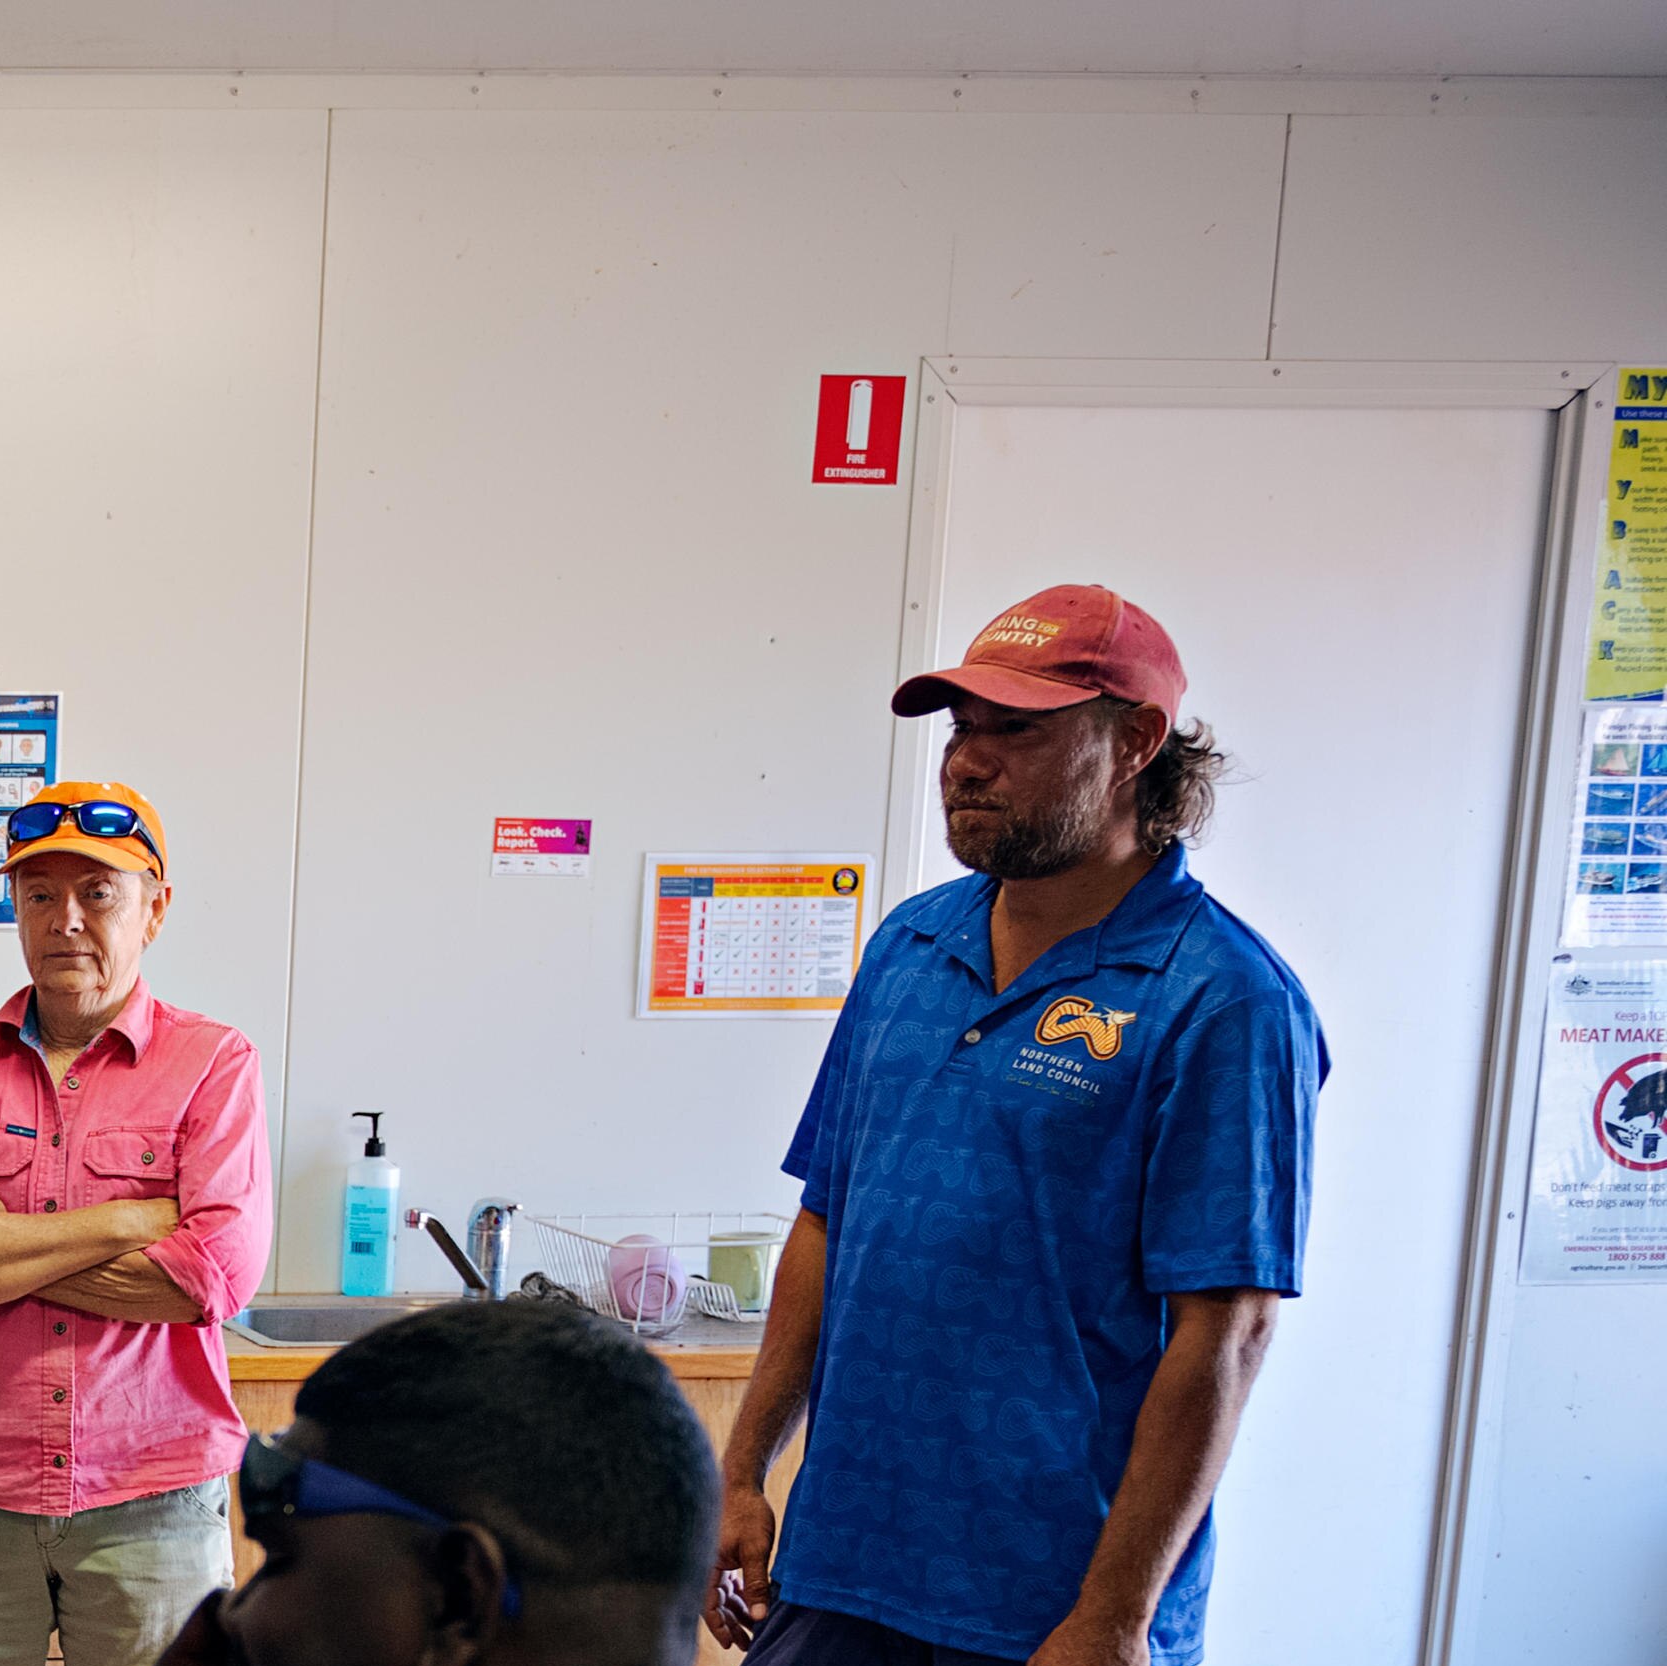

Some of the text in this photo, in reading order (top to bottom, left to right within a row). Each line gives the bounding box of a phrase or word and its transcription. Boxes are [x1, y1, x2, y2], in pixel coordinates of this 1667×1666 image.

[846, 453, 866, 464] FIRE
[824, 467, 886, 479] EXTINGUISHER
[498, 826, 567, 838] Look. Check.
[496, 837, 538, 849] Report.
[1615, 1011, 1639, 1022] Keep
[1560, 1028, 1667, 1042] MEAT MAKE
[1019, 1047, 1084, 1073] NORTHERN
[1012, 1059, 1101, 1095] LAND COUNCIL
[1551, 1183, 1578, 1193] Don't
[1608, 1183, 1632, 1193] meat
[1634, 1183, 1666, 1195] scraps
[1569, 1198, 1667, 1210] Keep pigs away fro
[1608, 1253, 1629, 1261] 1800
